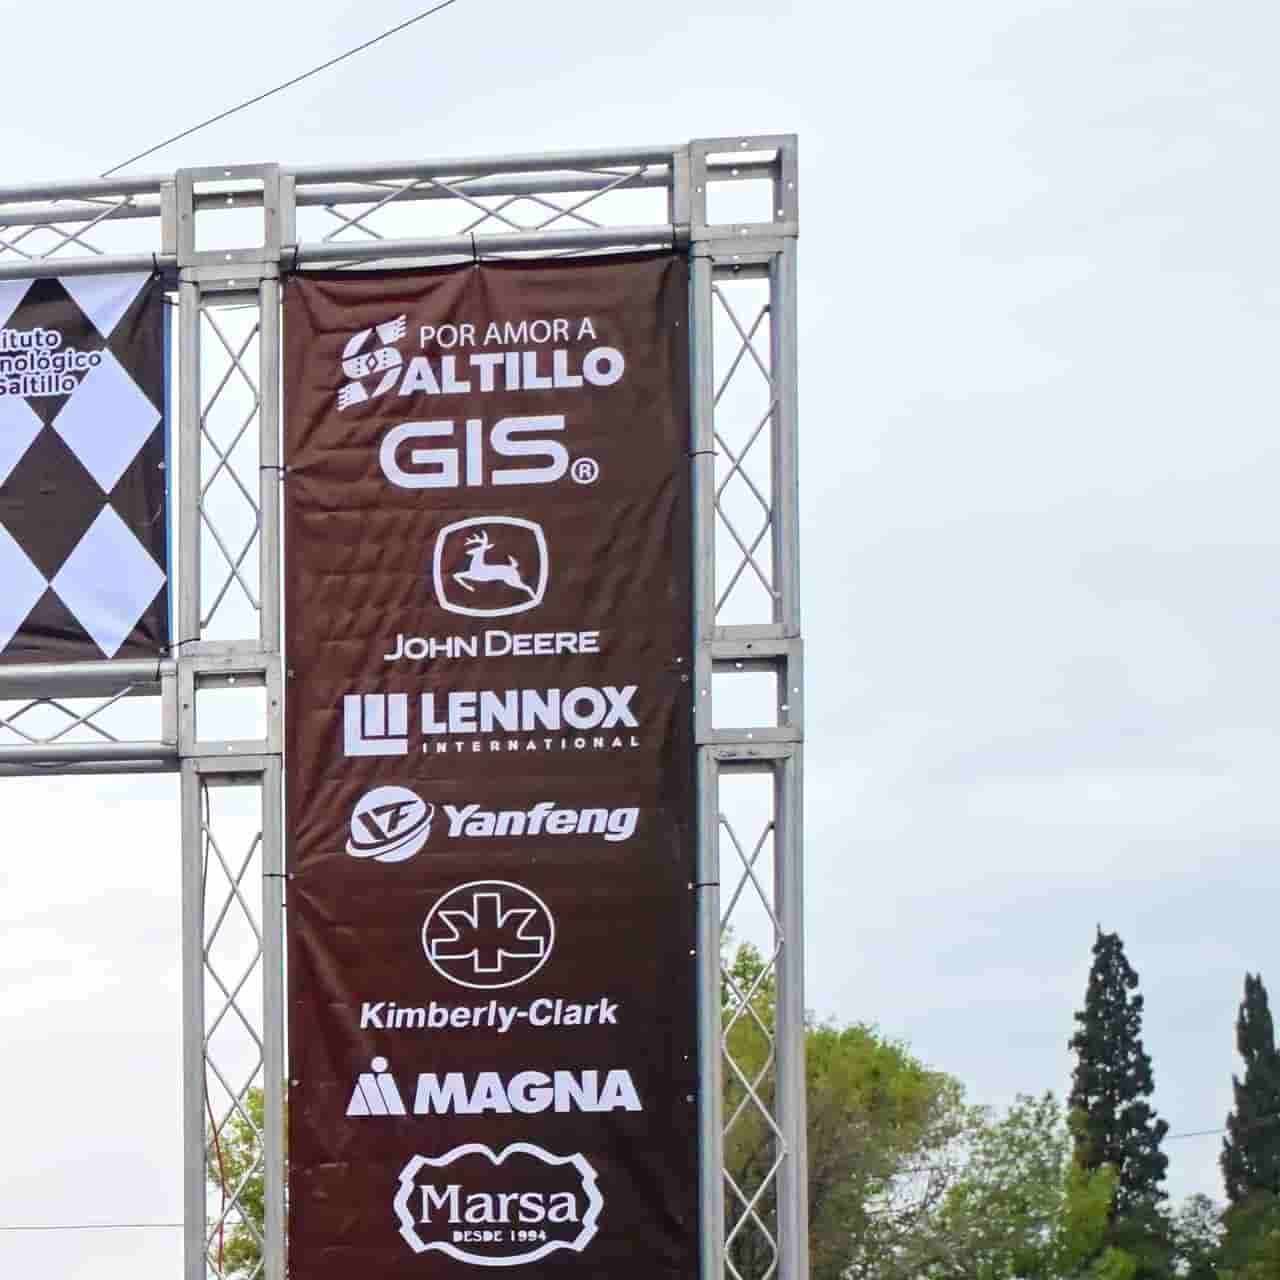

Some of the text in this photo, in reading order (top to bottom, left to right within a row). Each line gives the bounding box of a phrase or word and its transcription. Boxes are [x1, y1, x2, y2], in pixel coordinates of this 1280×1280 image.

[420, 317, 596, 348] POR AMOR A
[384, 630, 600, 660] JOHN DEERE
[421, 685, 640, 734] LENNOX
[422, 736, 640, 753] INTERNATIONAL
[443, 803, 640, 841] Yanfeng
[359, 998, 618, 1032] Kimberly-Clark
[413, 1069, 642, 1115] MAGNA
[419, 1184, 579, 1224] Marsa
[453, 1229, 547, 1242] DESDE 1994
